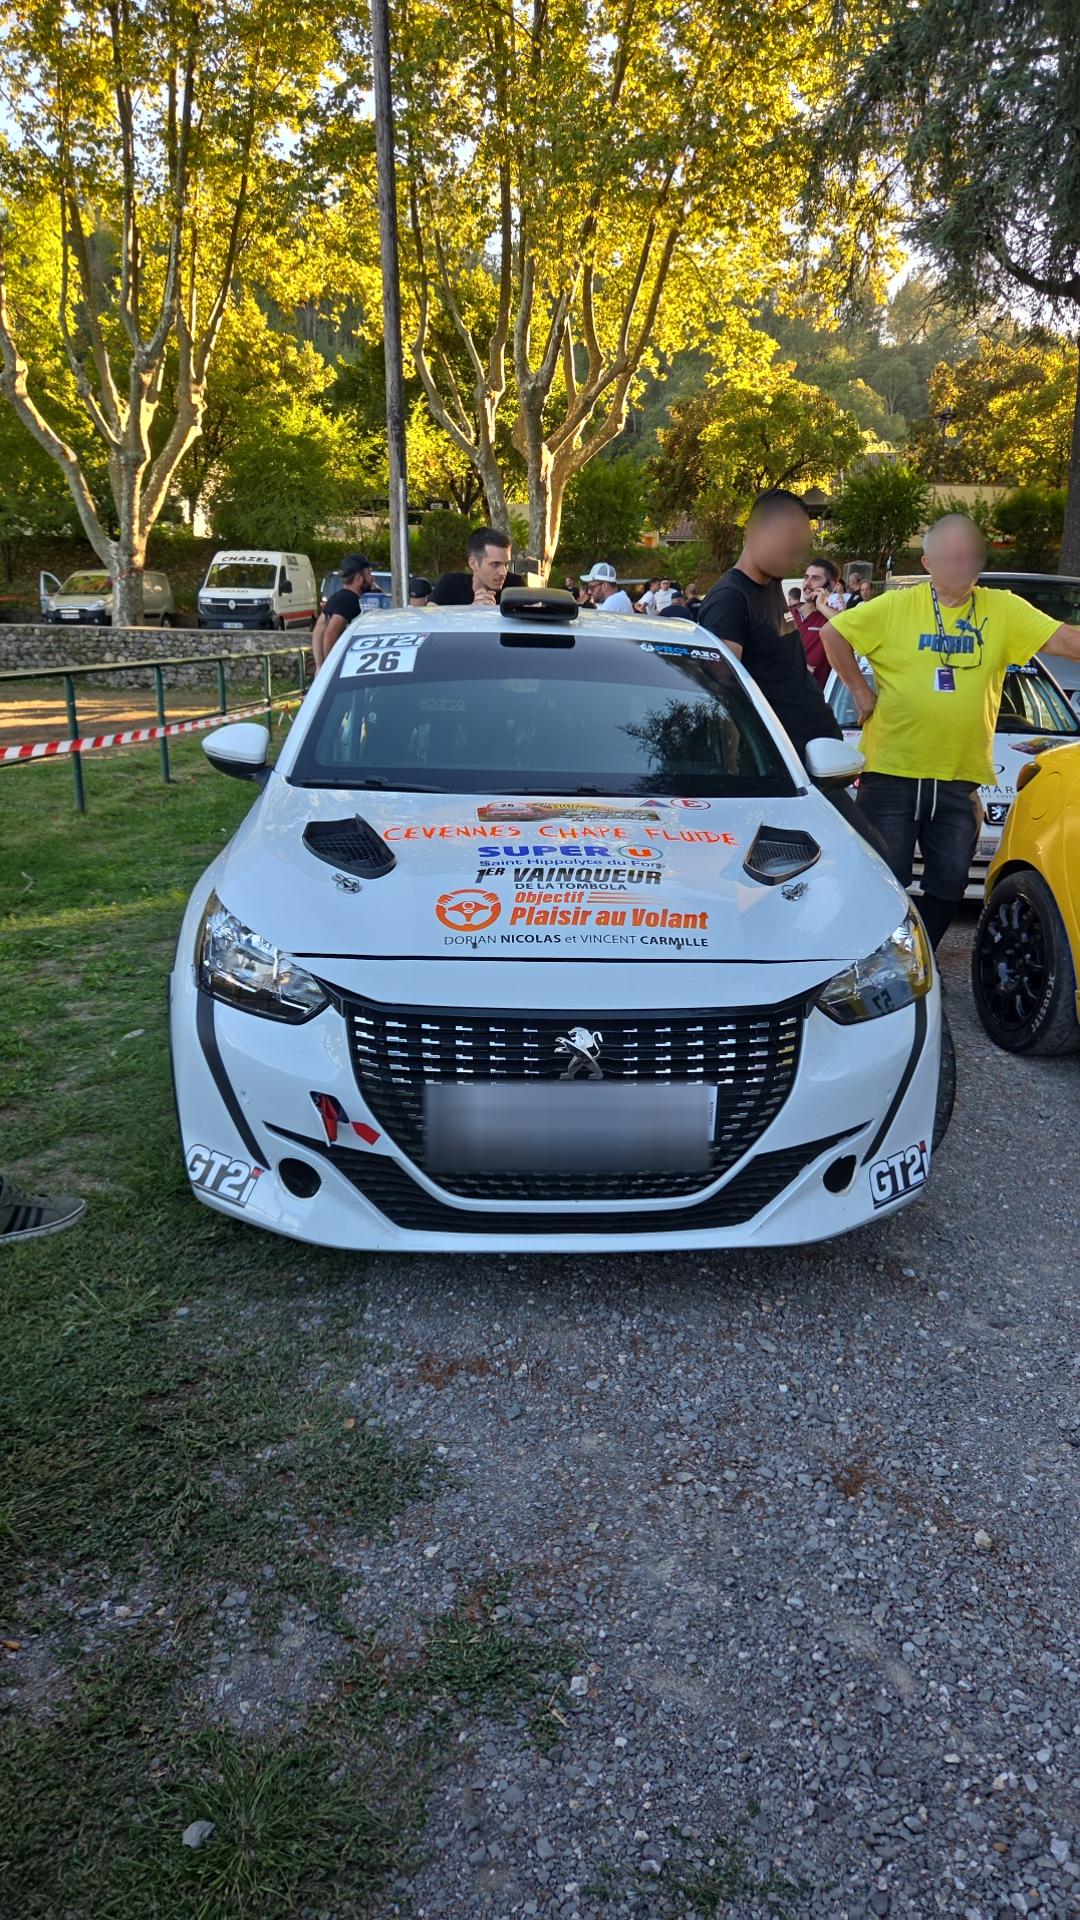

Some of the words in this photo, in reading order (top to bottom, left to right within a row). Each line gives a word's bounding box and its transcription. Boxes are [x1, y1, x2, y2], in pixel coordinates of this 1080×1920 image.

[221, 556, 270, 564] CHAZEL
[356, 651, 401, 674] 26
[383, 825, 522, 841] CEVENNES
[538, 825, 628, 840] CHAPE
[644, 828, 738, 845] FLUIDE
[478, 845, 611, 858] SUPER
[529, 858, 602, 866] Hippolyte
[513, 867, 663, 884] VAINQUEUR
[515, 891, 585, 905] Objectif
[510, 906, 592, 927] Plaisir
[595, 910, 626, 927] au
[631, 908, 709, 930] Volant
[444, 936, 497, 945] DORIAN
[501, 934, 561, 944] NICOLAS
[565, 935, 577, 944] et
[580, 934, 636, 945] VINCENT
[640, 935, 709, 947] CARMILLE
[186, 1143, 264, 1208] GT2i
[868, 1140, 930, 1206] GT2i
